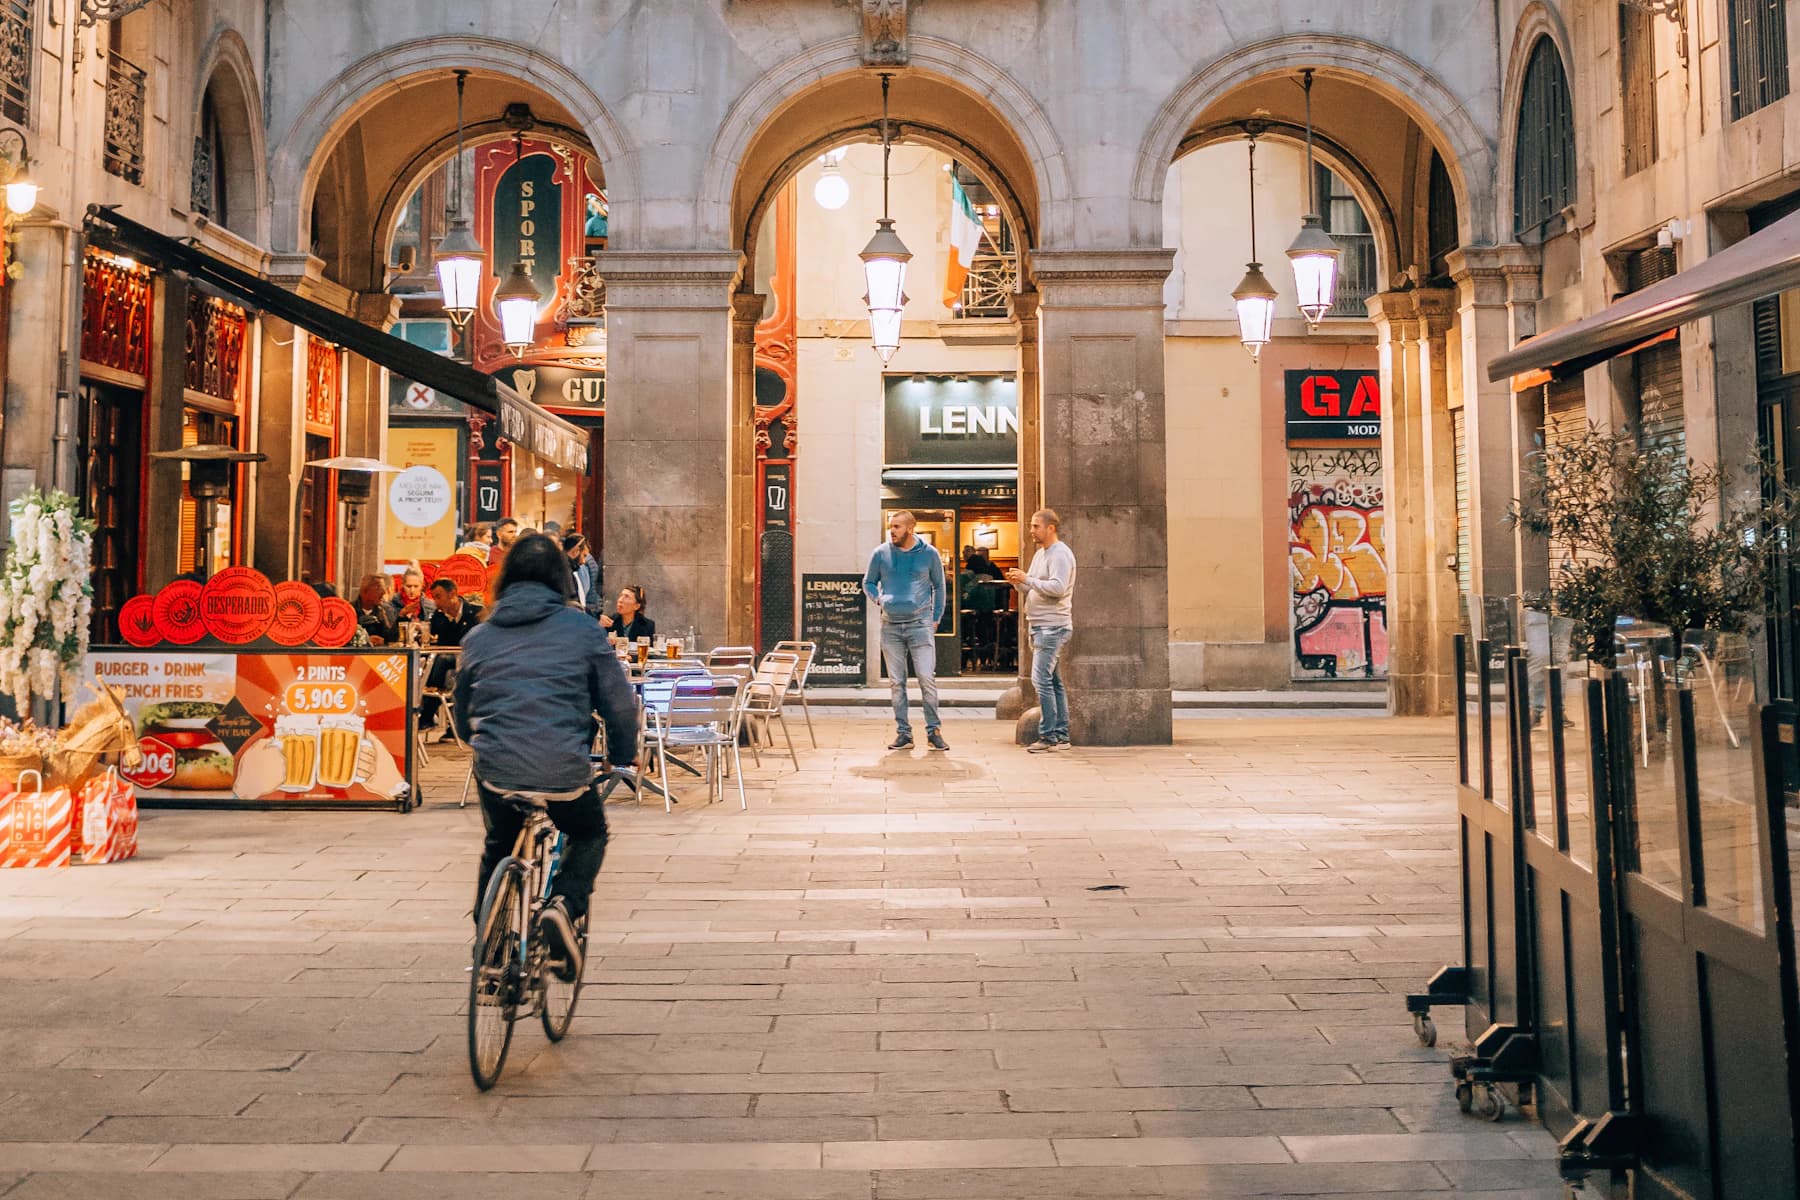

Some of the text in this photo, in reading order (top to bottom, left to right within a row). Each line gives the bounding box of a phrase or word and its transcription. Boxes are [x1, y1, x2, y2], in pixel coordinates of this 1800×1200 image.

[520, 181, 536, 276] SPORT
[806, 581, 859, 591] LENNOX
[207, 596, 270, 615] DESPERADOS
[94, 661, 206, 676] BURGER DRINK
[387, 655, 407, 674] ALL
[296, 666, 346, 681] 2 PINTS
[165, 684, 204, 698] FRIES
[294, 688, 348, 711] 5,90€
